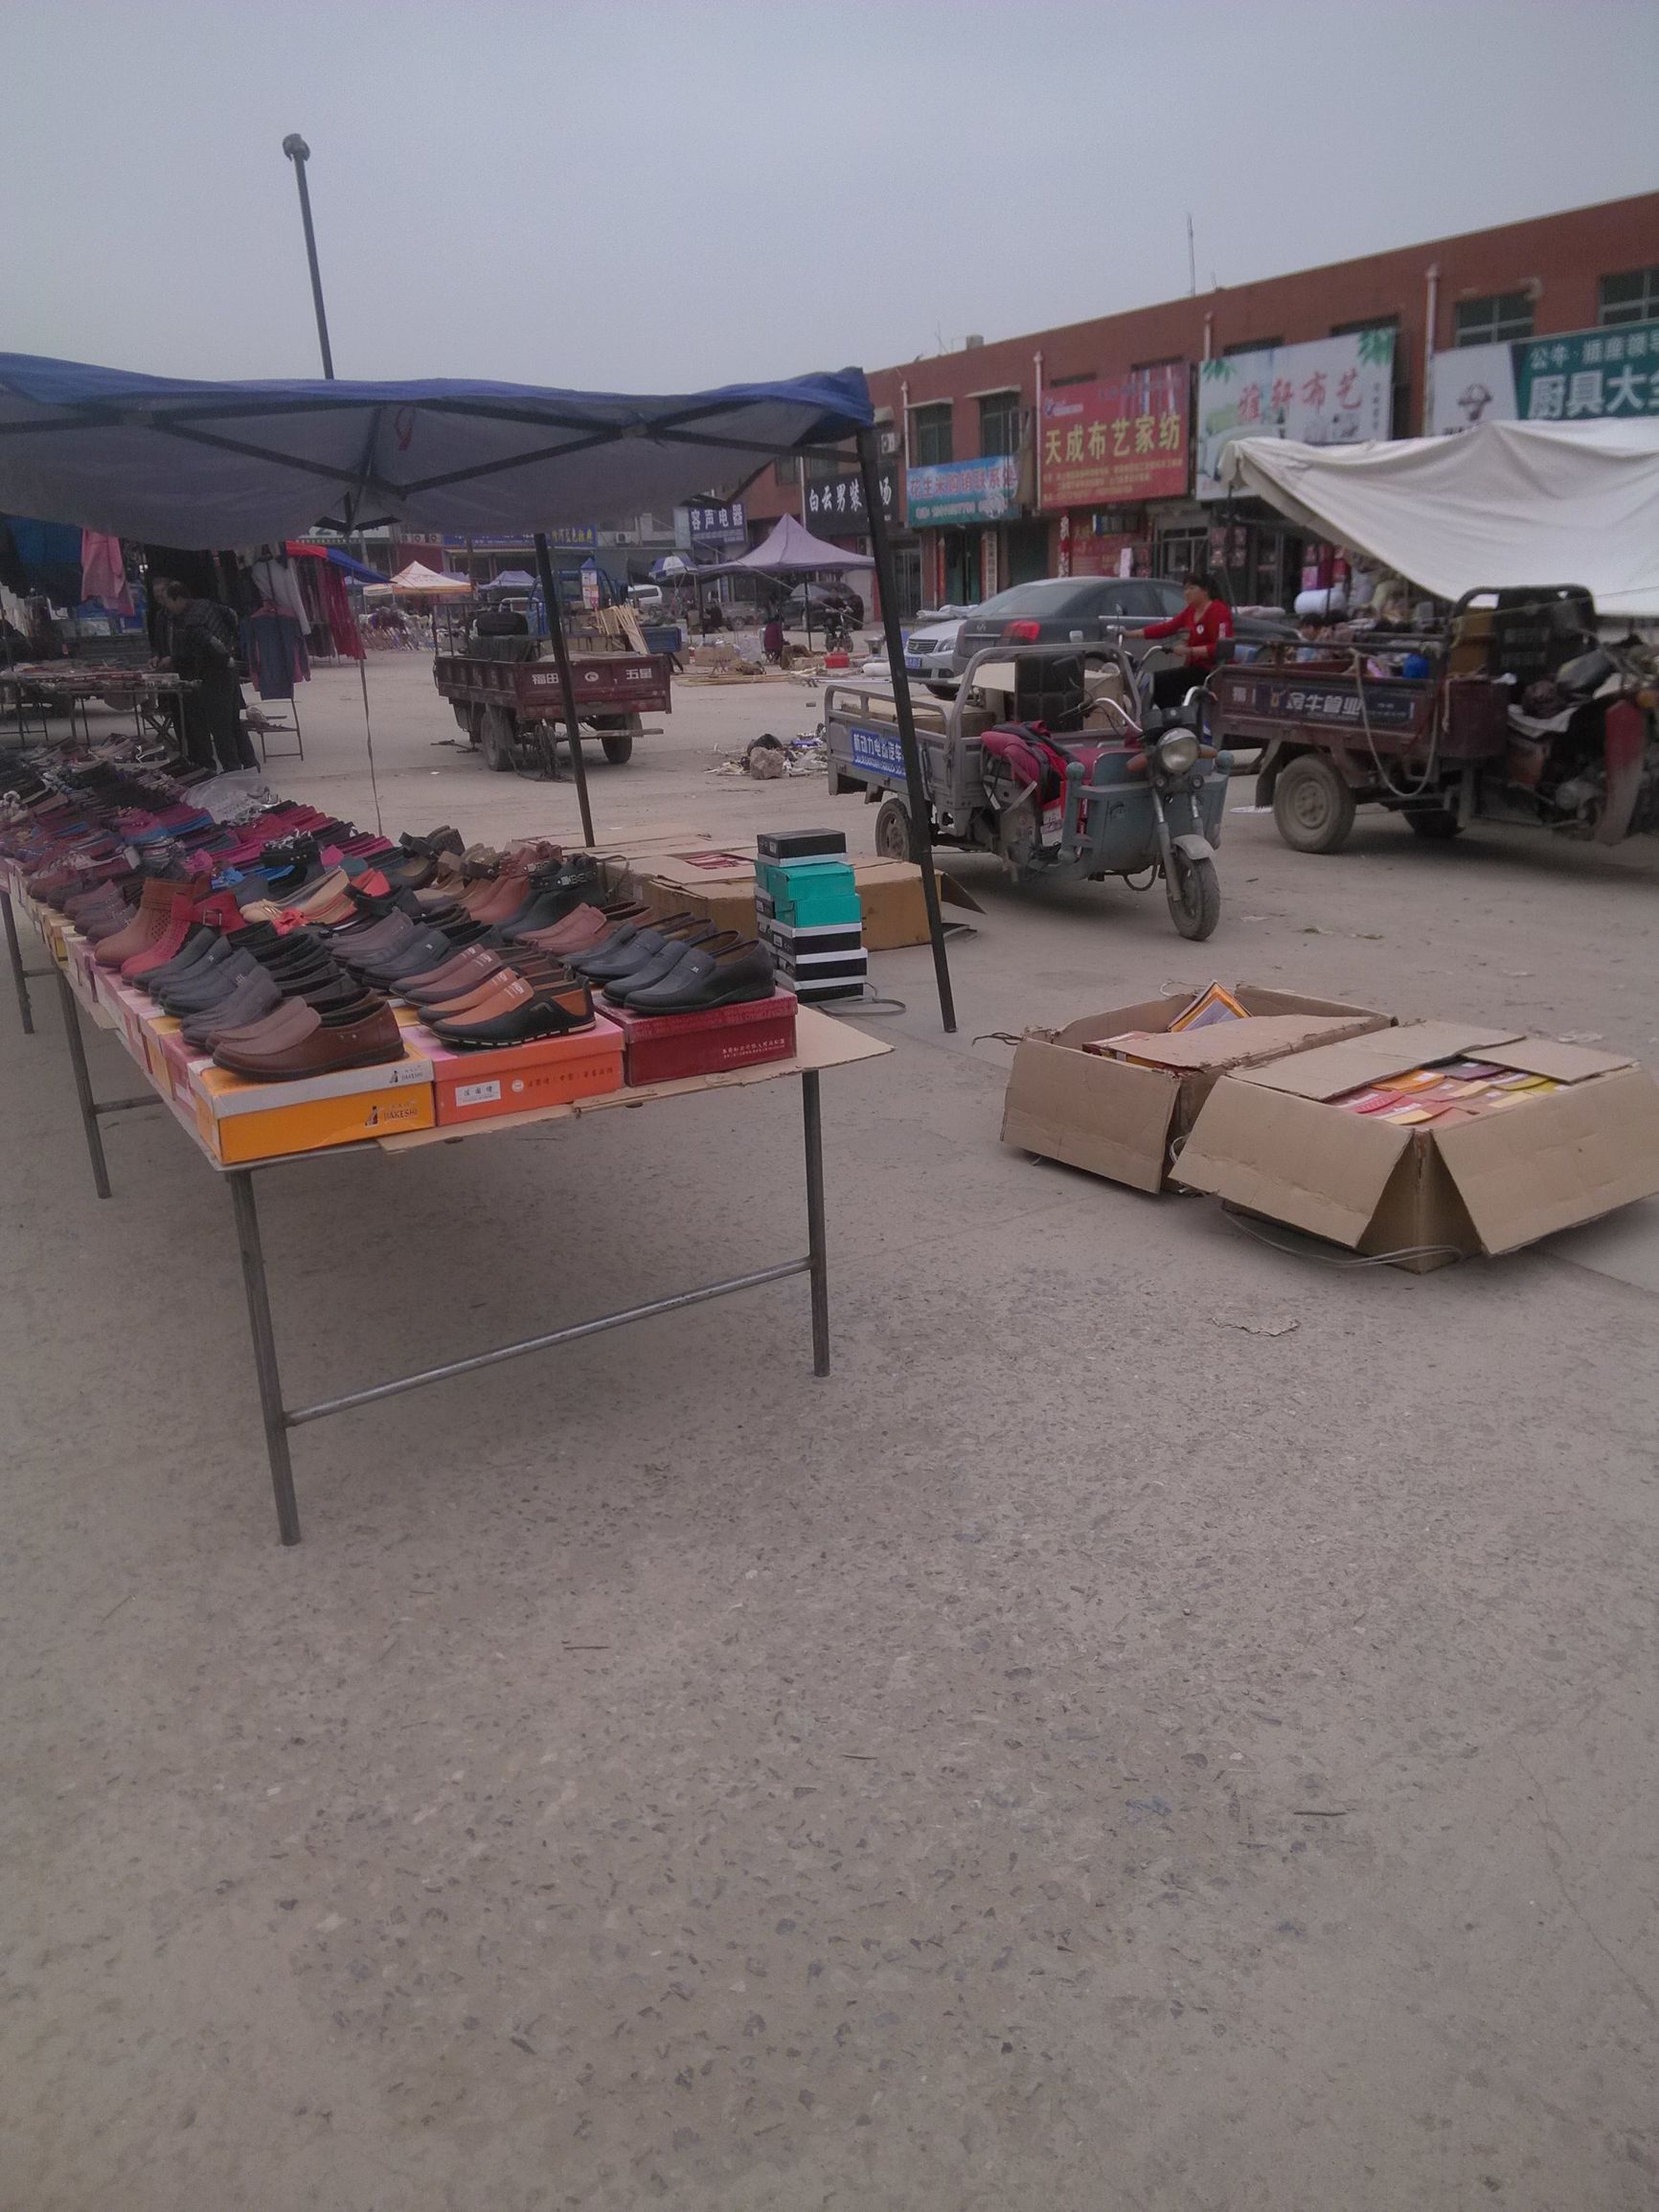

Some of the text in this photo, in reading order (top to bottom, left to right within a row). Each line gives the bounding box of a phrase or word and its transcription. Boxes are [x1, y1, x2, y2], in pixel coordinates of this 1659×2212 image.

[1045, 412, 1180, 466] 天成布艺家纺
[809, 477, 891, 513] 白云男装场
[691, 504, 743, 531] 容声电器
[533, 673, 559, 685] 福田
[625, 668, 652, 680] 五星
[1285, 692, 1360, 716] 金牛管业
